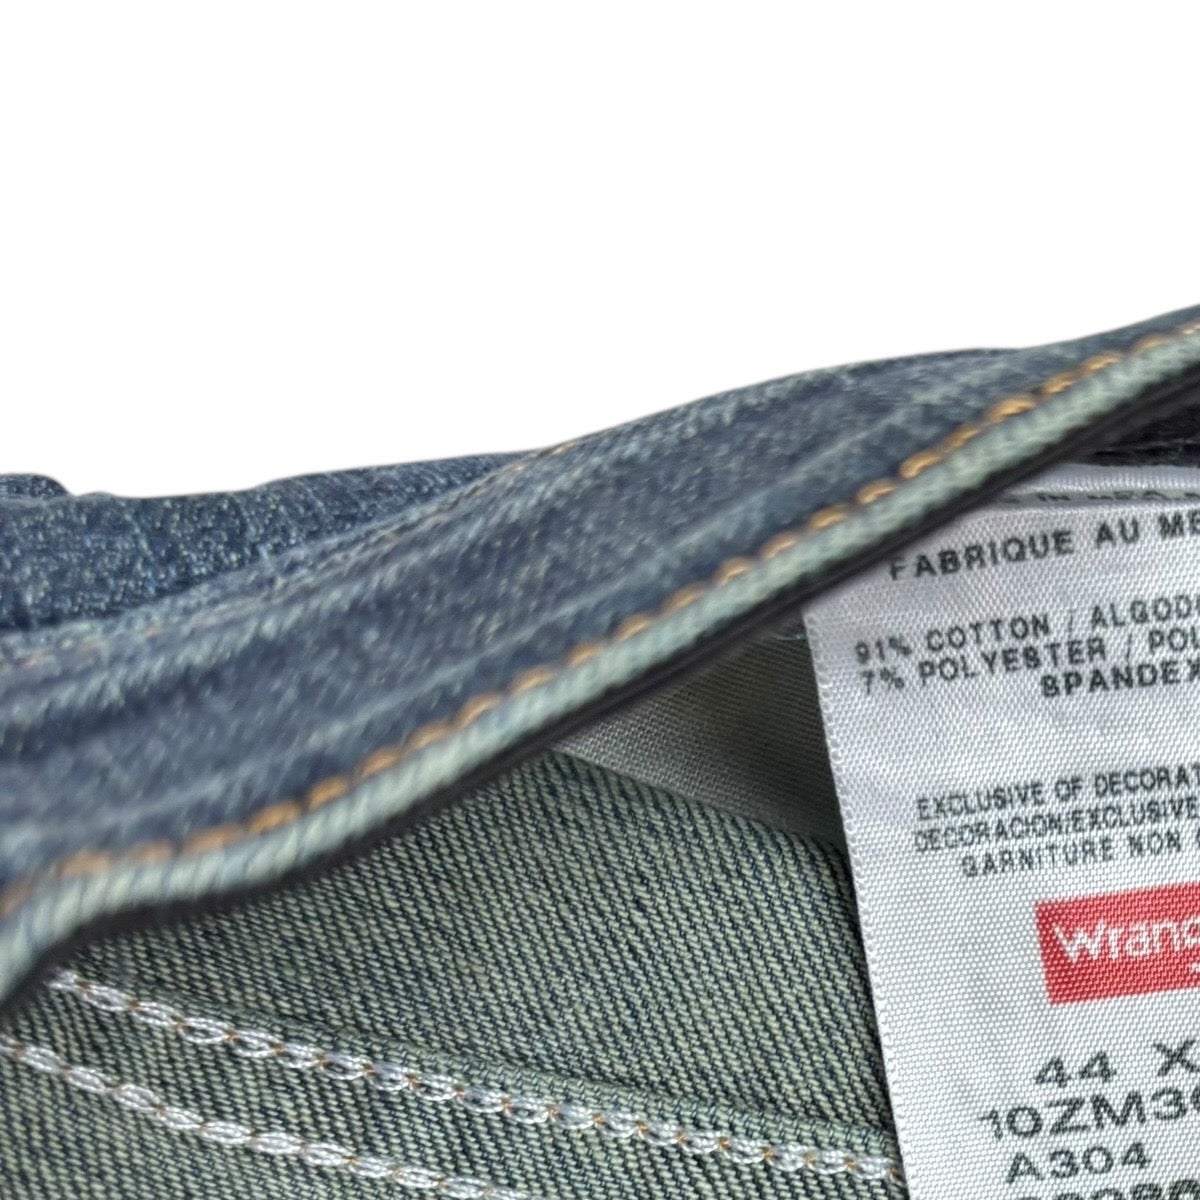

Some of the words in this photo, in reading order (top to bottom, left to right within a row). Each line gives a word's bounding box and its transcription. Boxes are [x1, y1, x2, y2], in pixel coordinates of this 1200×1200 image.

[889, 529, 1074, 581] FABRIQUE
[1096, 516, 1139, 549] AU
[854, 635, 912, 664] 91%
[926, 613, 1050, 653] COTTON
[862, 666, 905, 699] 7%
[917, 637, 1107, 686] POLYESTER
[918, 780, 1045, 821] EXCLUSIVE
[1054, 775, 1083, 802] OF
[961, 837, 1113, 877] GARNITURE
[1128, 828, 1182, 858] NON
[1033, 1050, 1118, 1089] 44
[1152, 1038, 1200, 1077] X
[1004, 1141, 1152, 1185] A304
